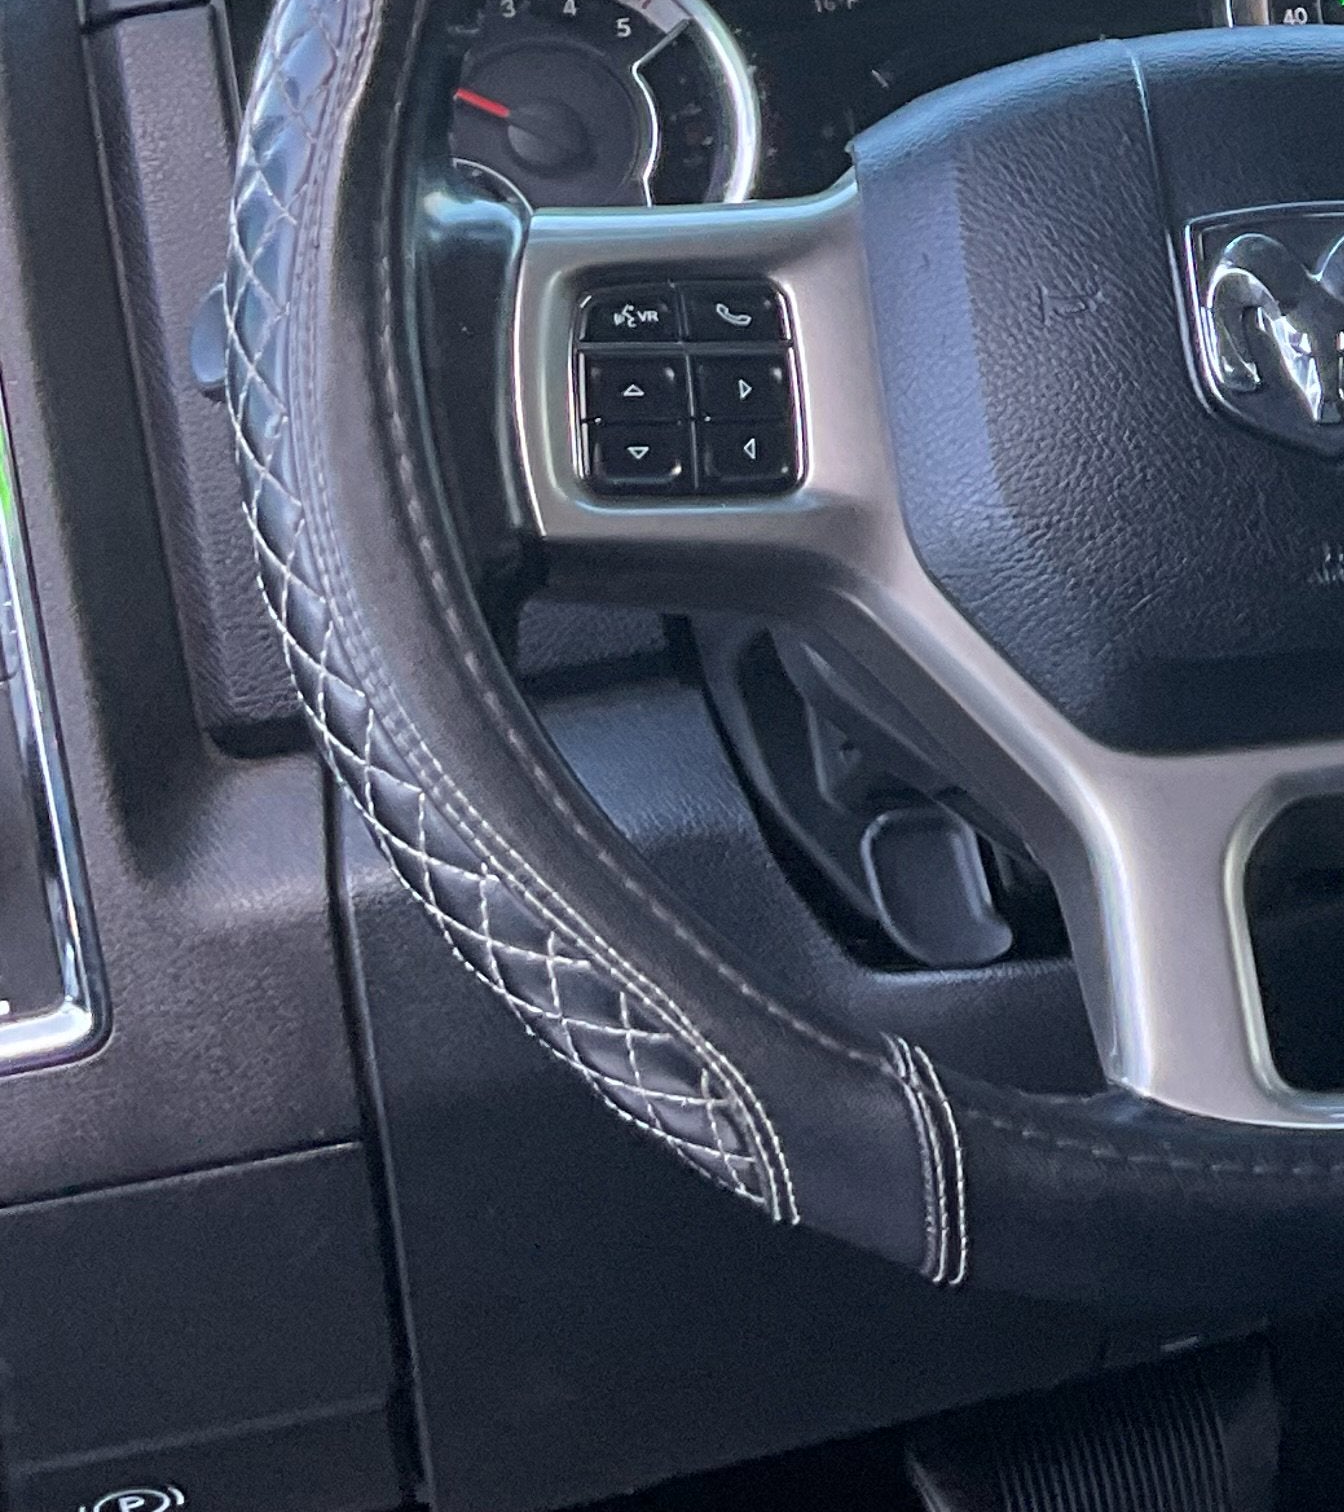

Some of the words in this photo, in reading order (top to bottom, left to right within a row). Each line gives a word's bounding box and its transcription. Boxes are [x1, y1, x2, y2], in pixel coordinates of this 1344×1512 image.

[1283, 7, 1308, 25] 40
[616, 17, 632, 37] 5
[636, 310, 659, 322] VR
